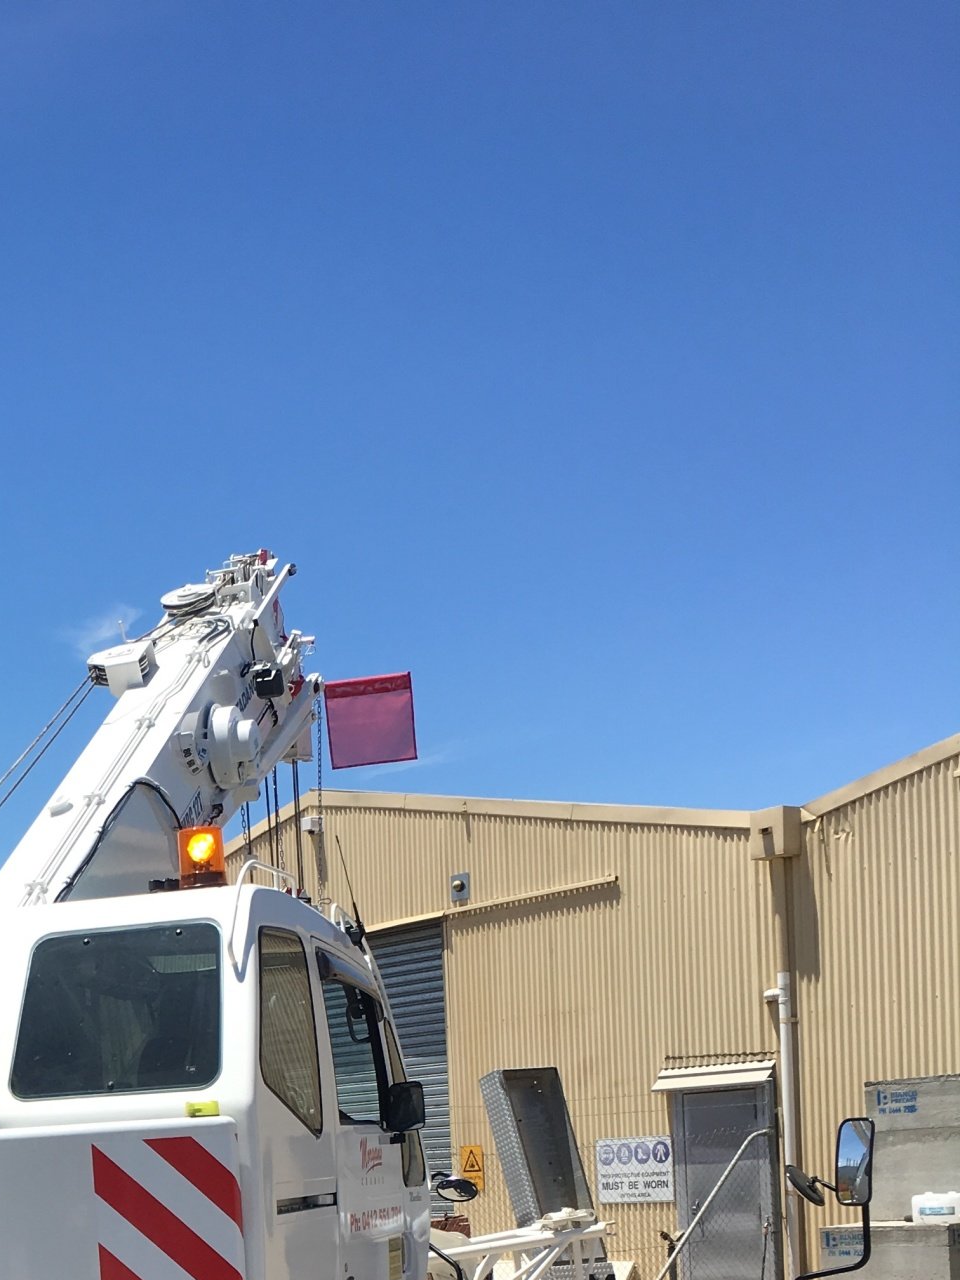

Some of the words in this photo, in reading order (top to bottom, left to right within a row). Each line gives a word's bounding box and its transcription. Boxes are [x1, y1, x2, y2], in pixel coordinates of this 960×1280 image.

[602, 1182, 624, 1190] MUST
[628, 1181, 639, 1189] BE
[643, 1180, 669, 1189] WORN
